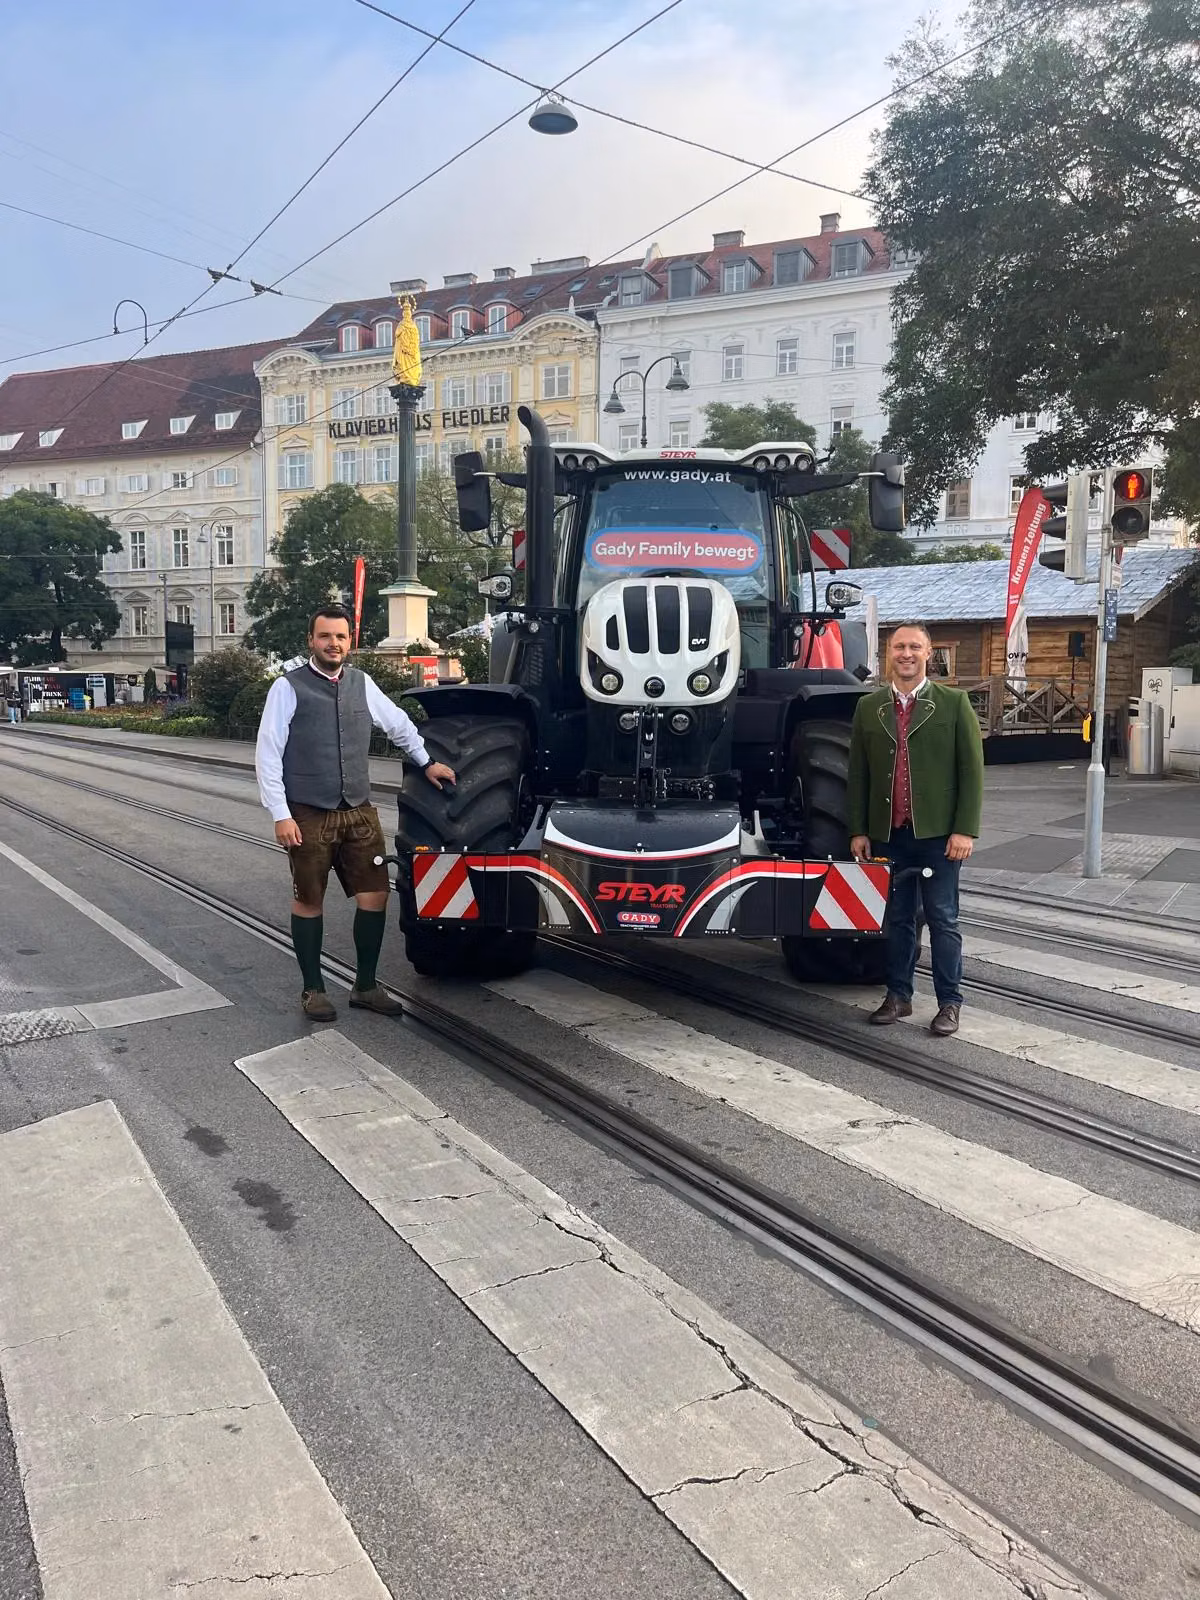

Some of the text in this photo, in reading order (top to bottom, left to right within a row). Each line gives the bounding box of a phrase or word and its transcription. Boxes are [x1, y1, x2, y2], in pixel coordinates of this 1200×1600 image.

[329, 405, 510, 439] KLAVIERHUS FIEDLER
[659, 451, 697, 459] STEYR
[624, 470, 731, 483] www.gady.at
[595, 542, 755, 561] Gady Family bewegt
[1011, 503, 1047, 585] Kronen Zeitung
[594, 881, 686, 903] STEYR
[621, 913, 656, 923] GADY
